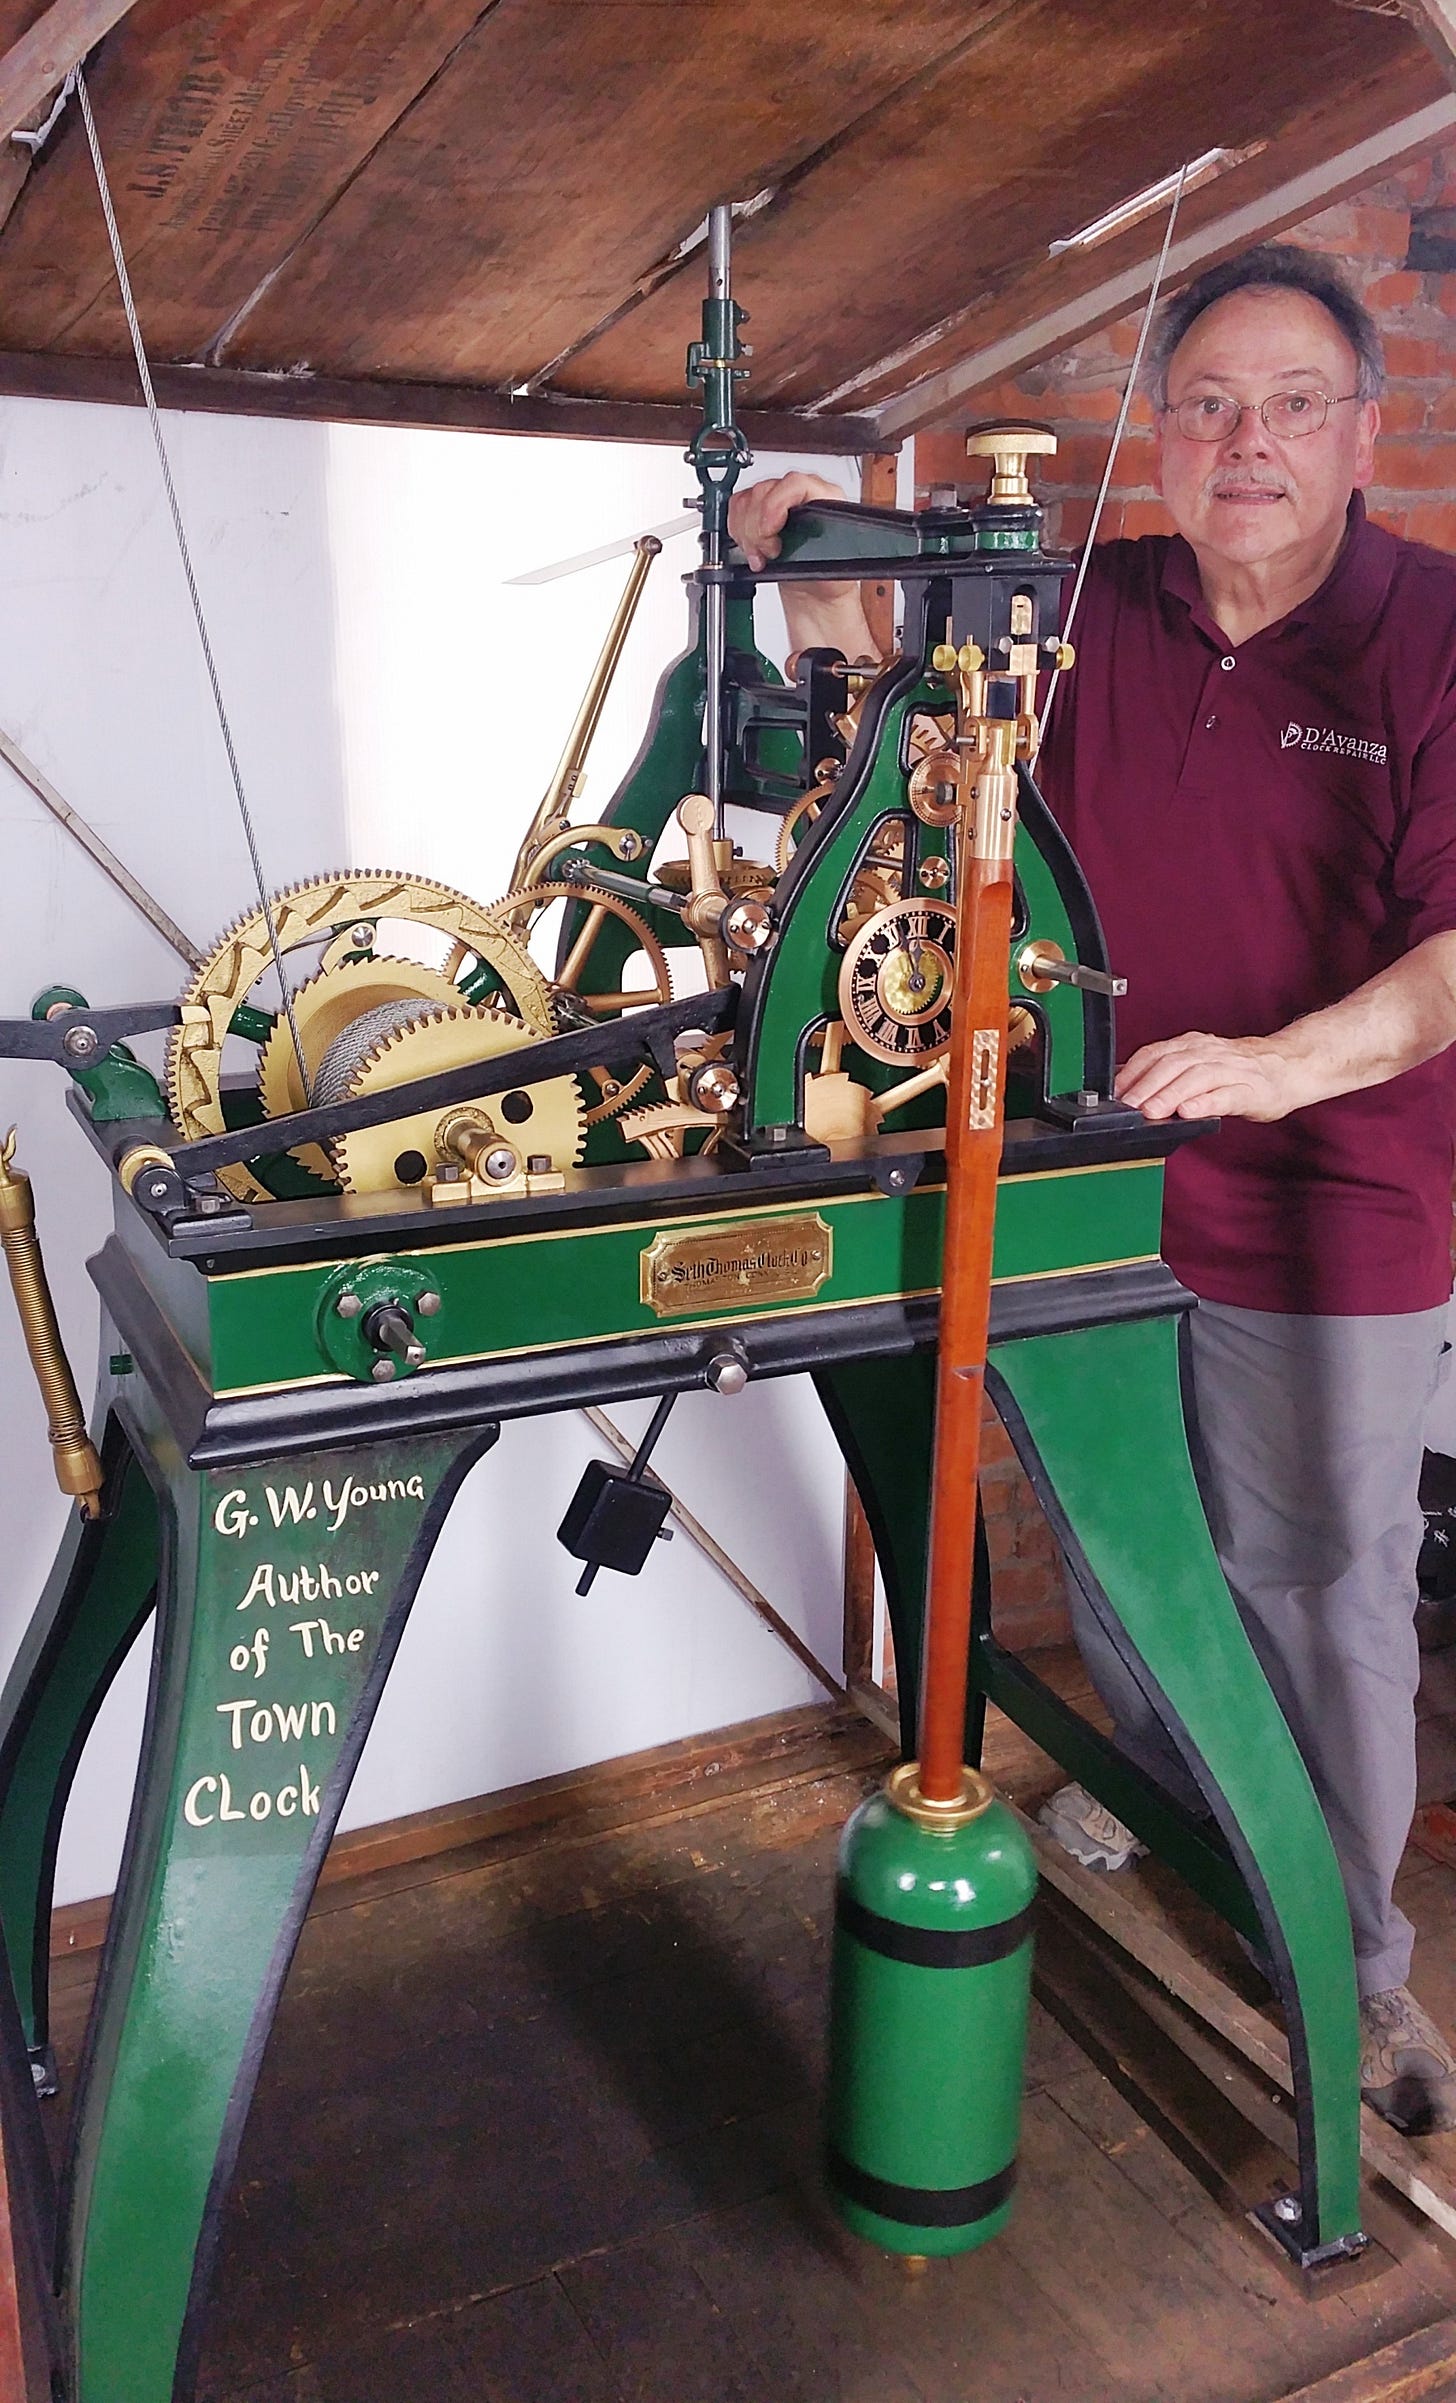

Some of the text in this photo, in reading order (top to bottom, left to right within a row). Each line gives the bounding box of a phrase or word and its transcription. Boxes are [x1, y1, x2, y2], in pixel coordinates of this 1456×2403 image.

[1300, 742, 1331, 752] CLOCK
[1369, 754, 1387, 765] LLC
[1303, 727, 1388, 758] D'Avanza
[907, 916, 929, 939] XII
[671, 1261, 705, 1283] Seth
[705, 1256, 757, 1279] Thomas
[757, 1250, 791, 1269] Clock
[322, 1475, 425, 1531] Young
[236, 1563, 379, 1611] Author
[230, 1618, 365, 1679] of The
